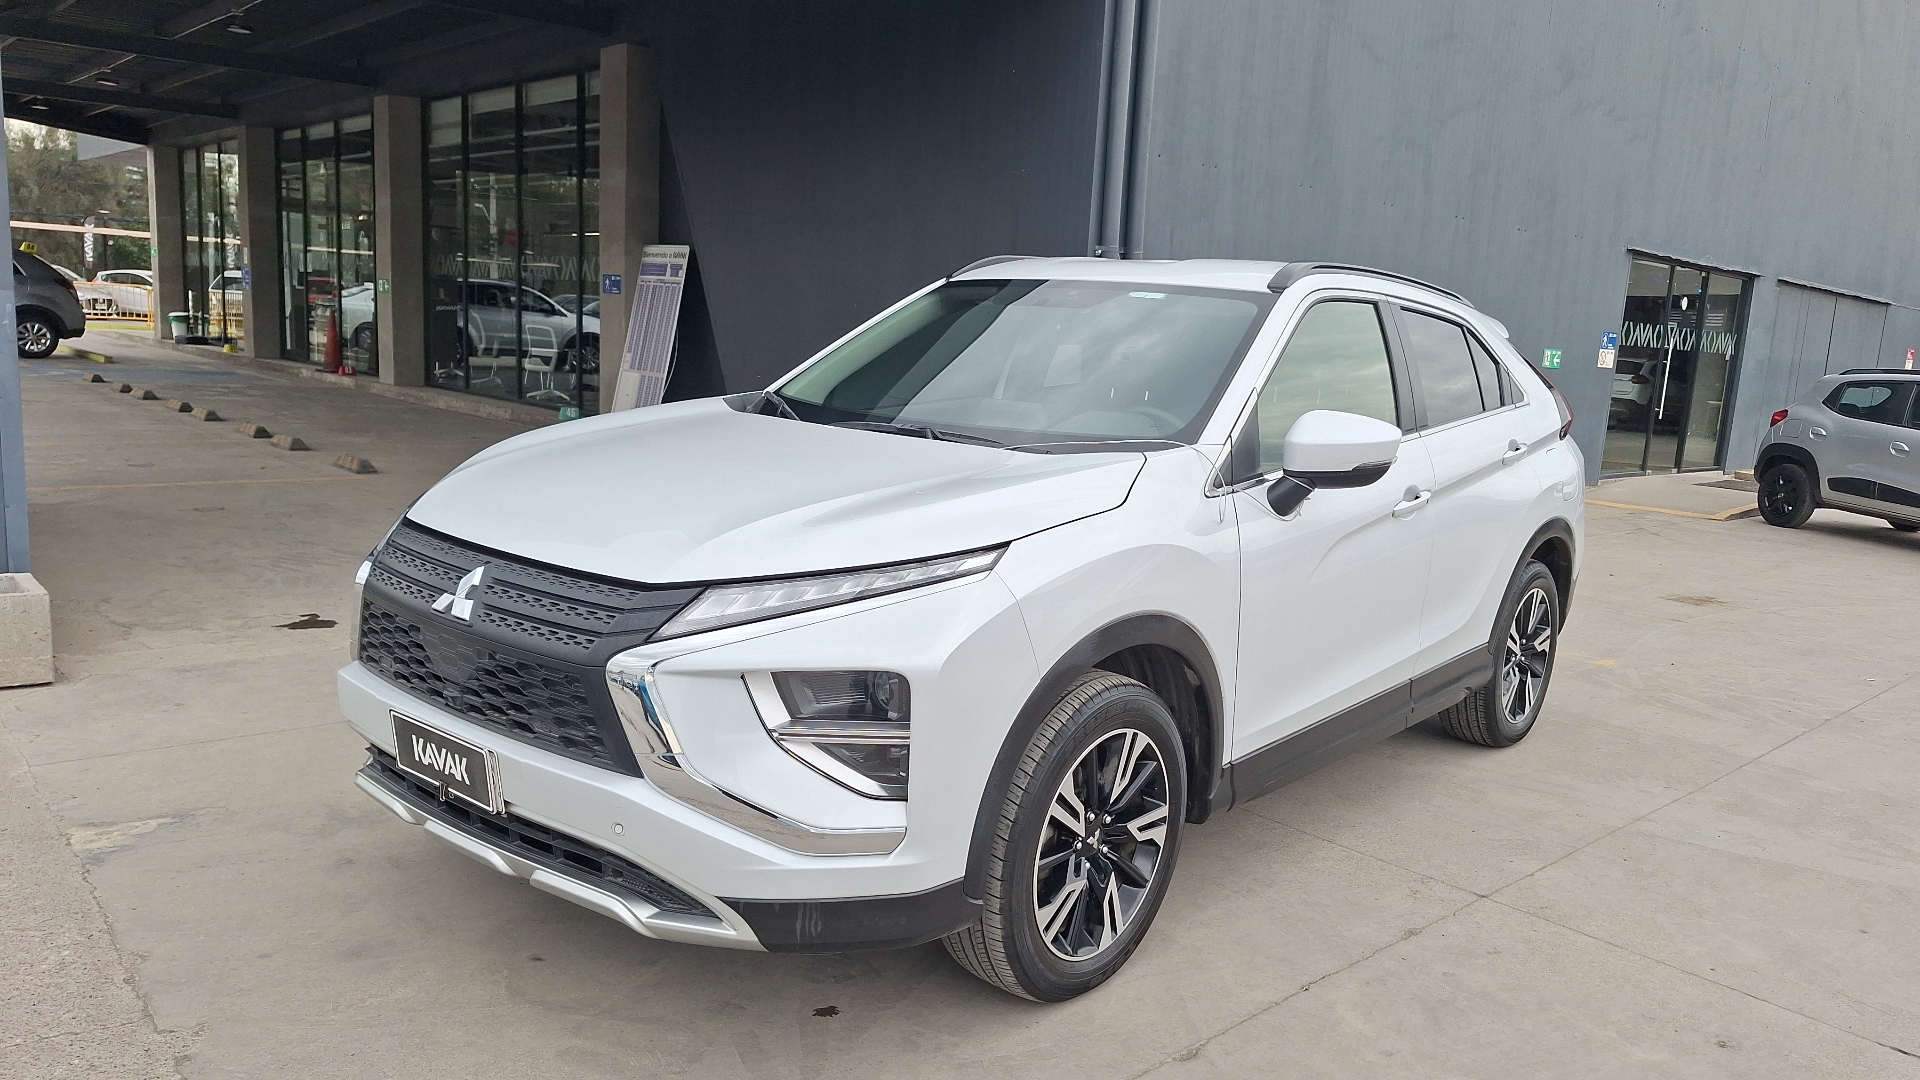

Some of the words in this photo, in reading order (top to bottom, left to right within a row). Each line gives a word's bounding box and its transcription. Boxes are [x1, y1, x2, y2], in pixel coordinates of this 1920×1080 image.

[643, 251, 668, 259] Bienvenido
[673, 251, 687, 259] KAVAK
[566, 407, 576, 418] 45
[411, 734, 471, 786] KAVAK
